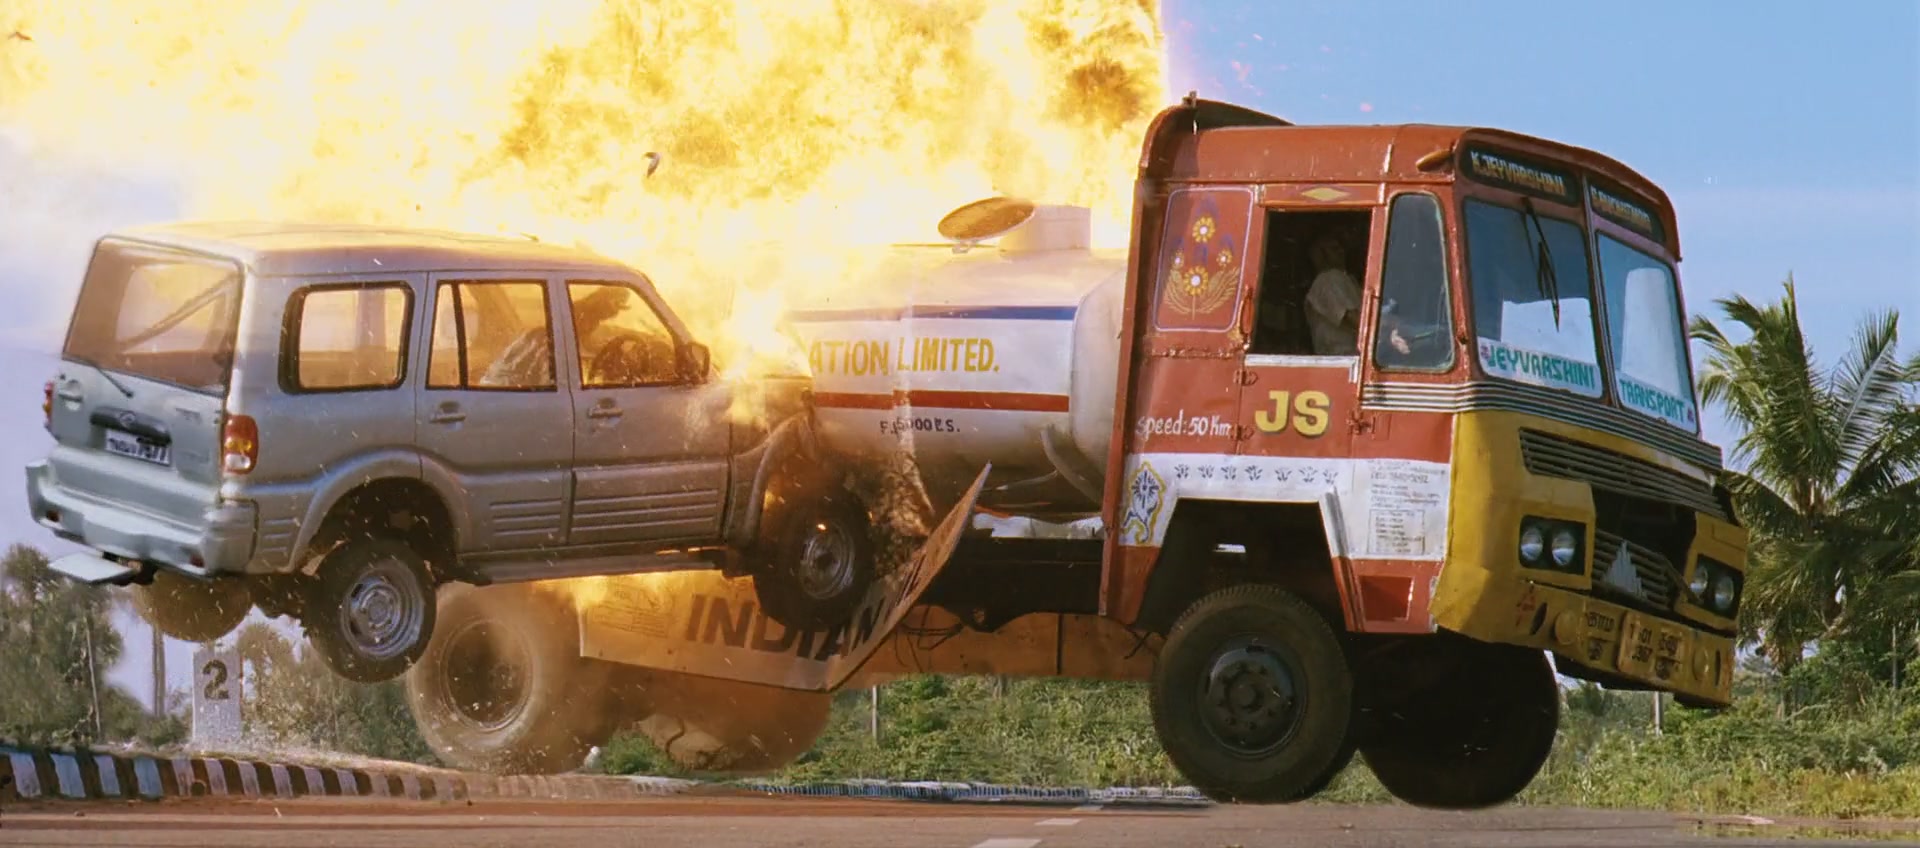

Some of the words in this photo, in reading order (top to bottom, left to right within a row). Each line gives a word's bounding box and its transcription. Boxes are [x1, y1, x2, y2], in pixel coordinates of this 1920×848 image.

[896, 337, 1000, 373] LIMITED.
[1486, 344, 1597, 390] JEYVARSHINI
[1254, 390, 1330, 437] JS
[1618, 378, 1685, 417] TRANSPORT
[1188, 416, 1208, 436] 50
[202, 658, 230, 700] 2
